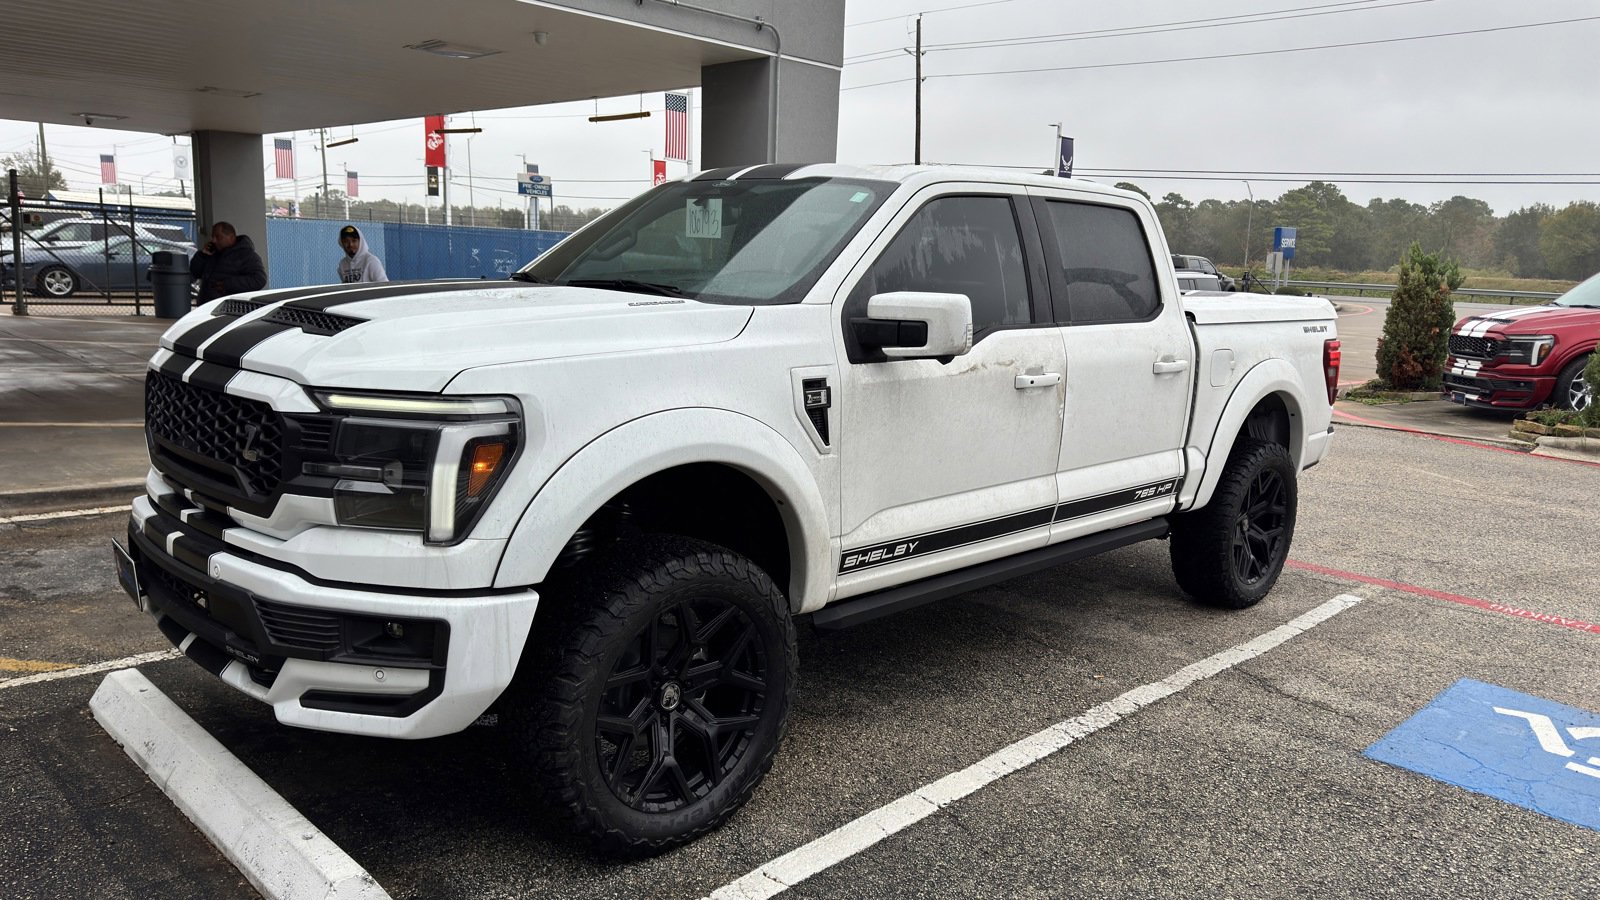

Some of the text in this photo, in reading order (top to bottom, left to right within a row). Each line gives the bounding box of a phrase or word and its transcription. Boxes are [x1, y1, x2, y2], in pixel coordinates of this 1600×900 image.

[526, 188, 548, 196] VEHICLES
[1281, 238, 1296, 248] SERVICE
[1134, 482, 1173, 500] 785 HP
[843, 541, 919, 568] SHELBY
[226, 645, 260, 664] SHELBY
